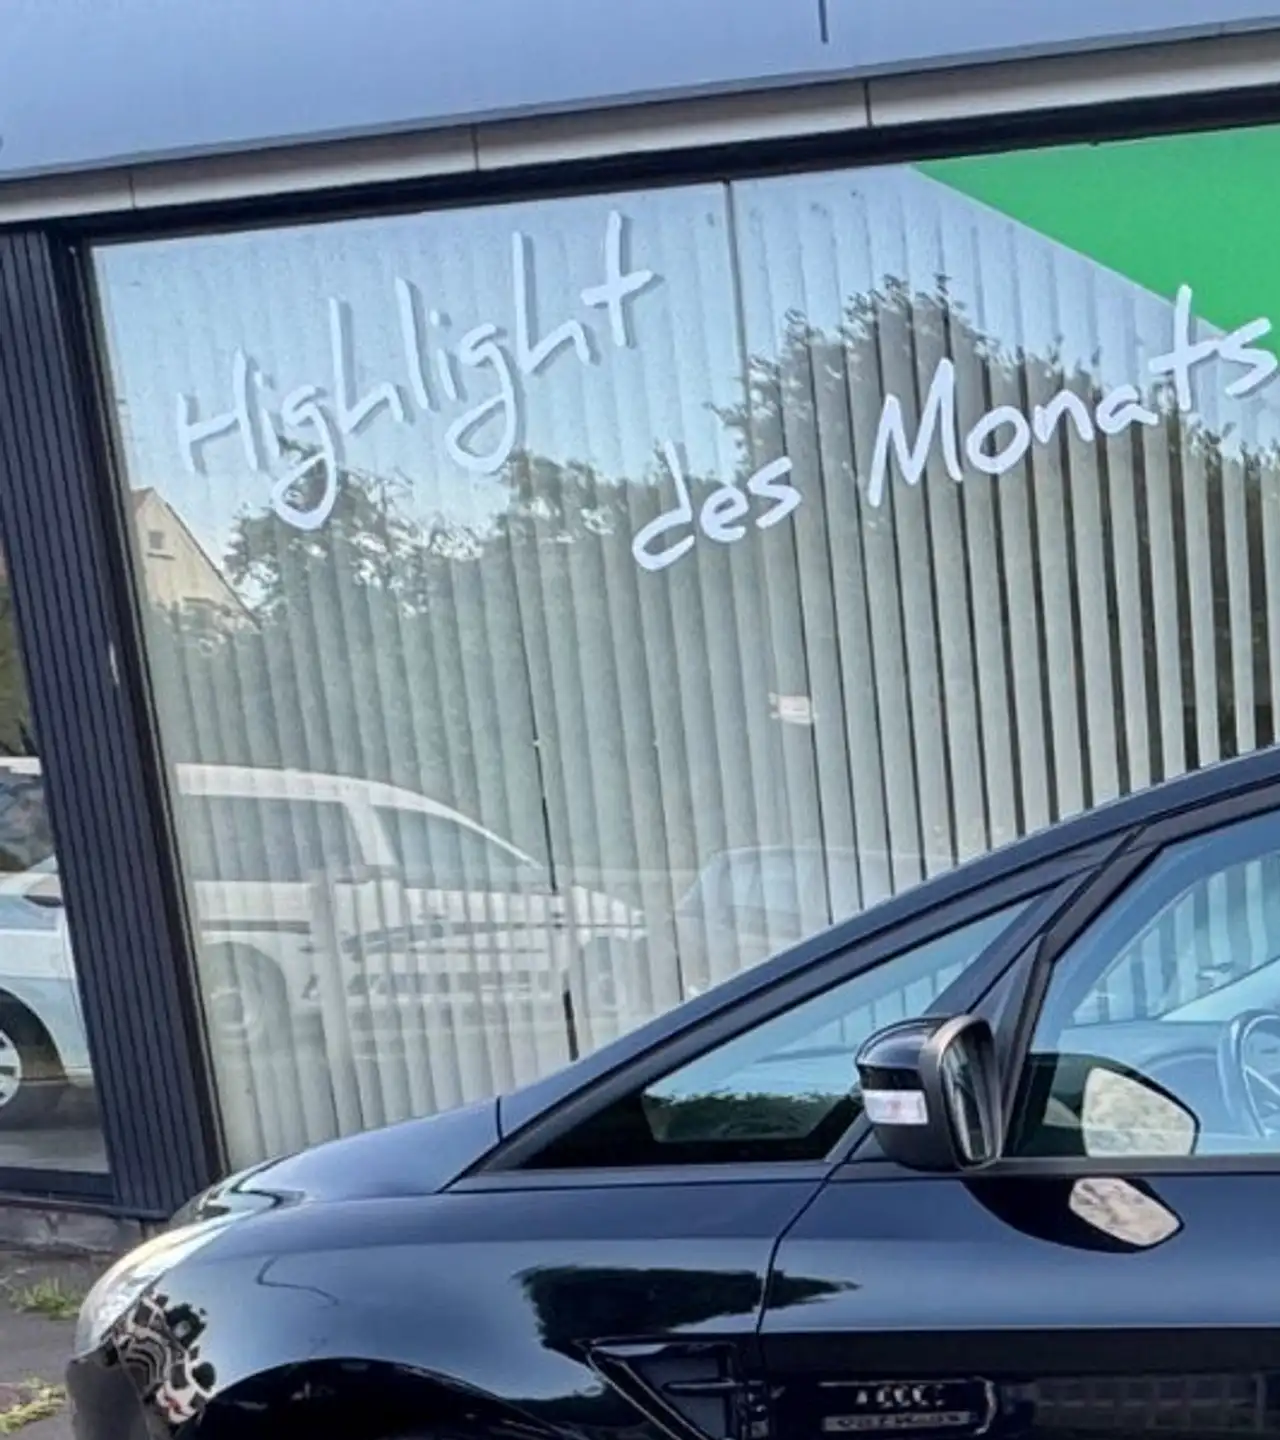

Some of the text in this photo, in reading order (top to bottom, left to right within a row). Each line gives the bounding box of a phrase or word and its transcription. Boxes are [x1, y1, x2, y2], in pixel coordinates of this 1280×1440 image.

[177, 210, 656, 530] Highlight
[631, 283, 1279, 572] des Monats
